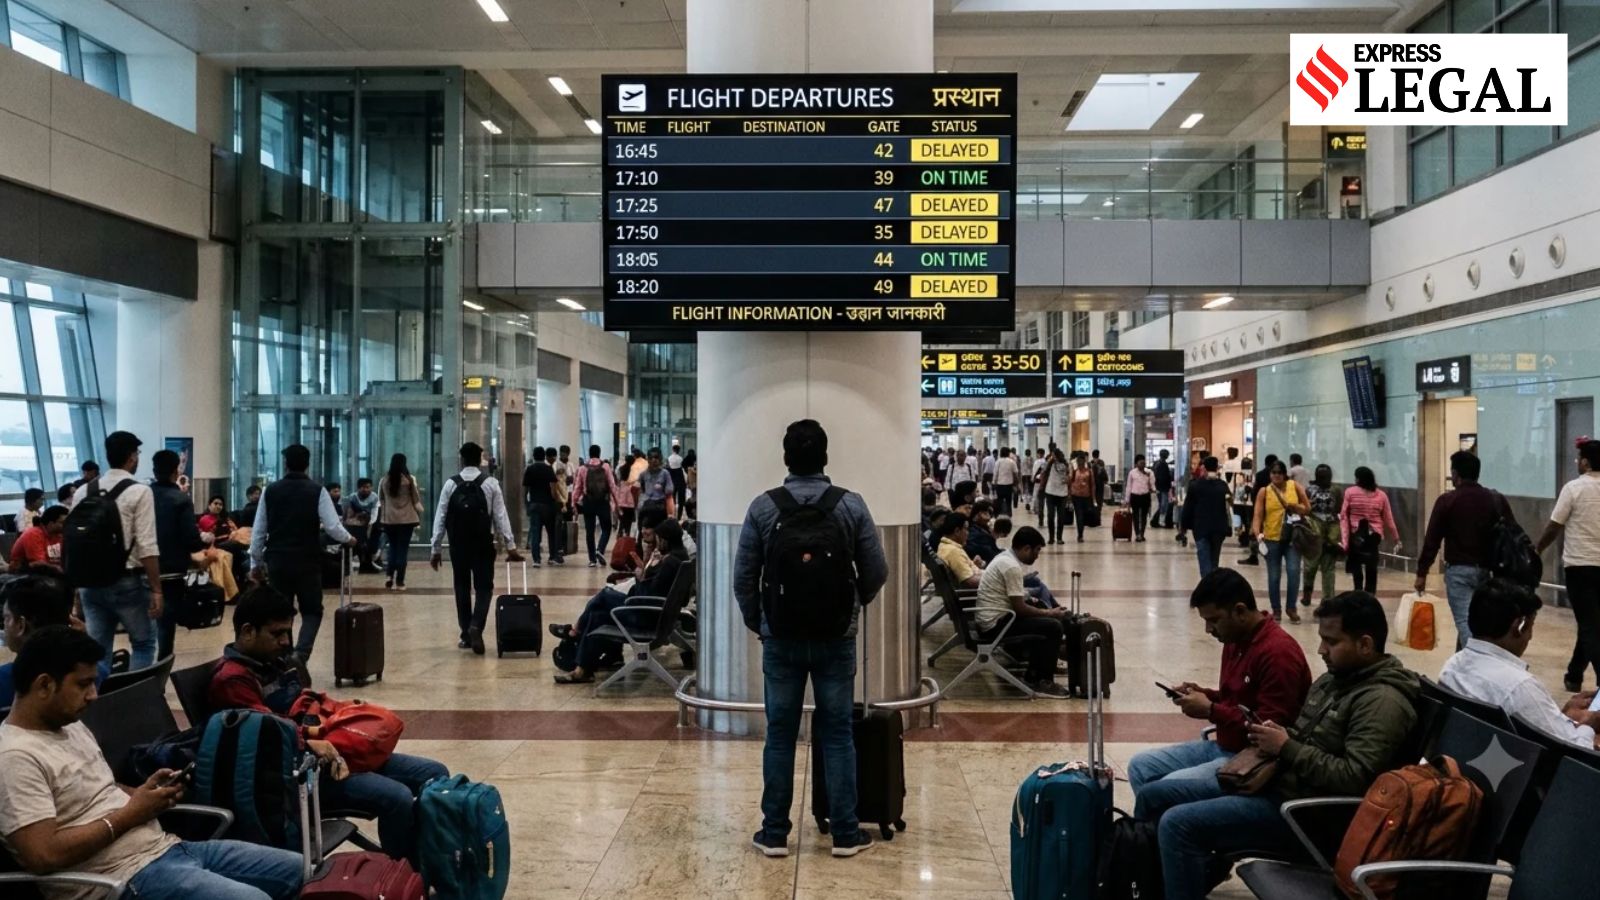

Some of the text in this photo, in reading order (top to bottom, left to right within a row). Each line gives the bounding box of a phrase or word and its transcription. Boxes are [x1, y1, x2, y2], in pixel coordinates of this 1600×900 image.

[668, 88, 893, 108] FLIGHT DEPARTURES
[933, 87, 1001, 107] प्रस्थान
[615, 121, 977, 133] TIME FLIGHT DESTINATION GATE STATUS
[616, 143, 988, 158] 16:45 42 DELAYED
[617, 171, 987, 185] 17:10 39 ON TIME
[616, 198, 988, 212] 17:25 47 DELAYED
[617, 225, 988, 239] 17:50 35 DELAYED
[617, 252, 987, 266] 18:05 44 ON TIME
[618, 280, 987, 294] 18:20 49 DELAYED
[673, 307, 723, 319] FLIGHT
[729, 307, 832, 320] INFORMATION
[886, 302, 945, 320] जानकारी
[993, 355, 1040, 370] 35-50
